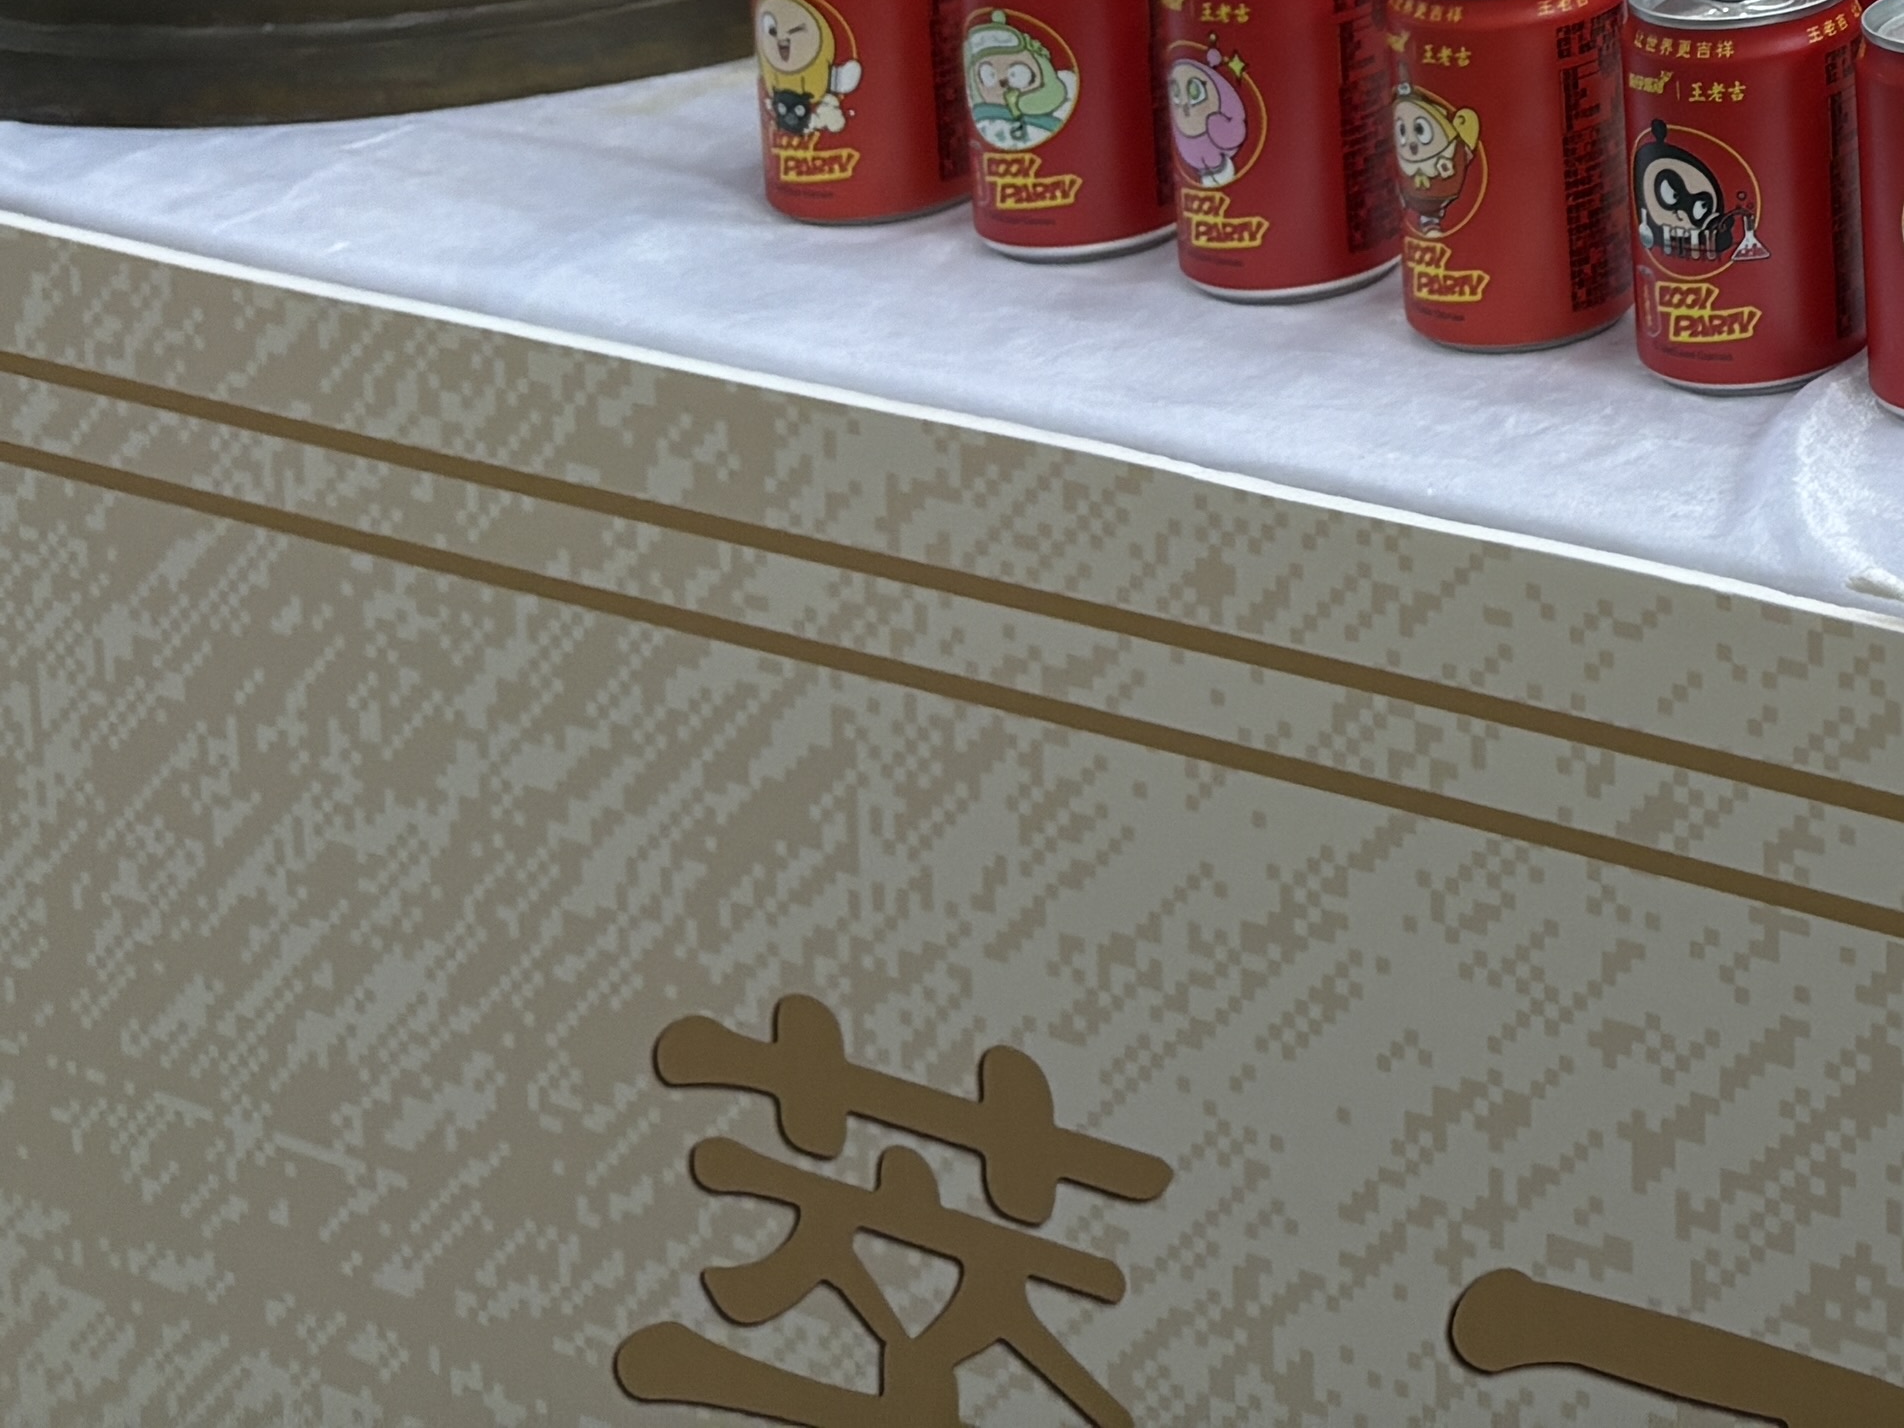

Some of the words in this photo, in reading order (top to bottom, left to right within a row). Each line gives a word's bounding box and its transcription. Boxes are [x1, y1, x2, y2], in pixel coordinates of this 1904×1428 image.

[1199, 3, 1251, 25] 王老吉
[1806, 11, 1850, 45] 王老吉
[1421, 44, 1472, 68] 王老吉
[1634, 33, 1736, 61] 让世界更吉祥
[1688, 80, 1747, 104] 王老吉
[1673, 310, 1756, 341] PARTY
